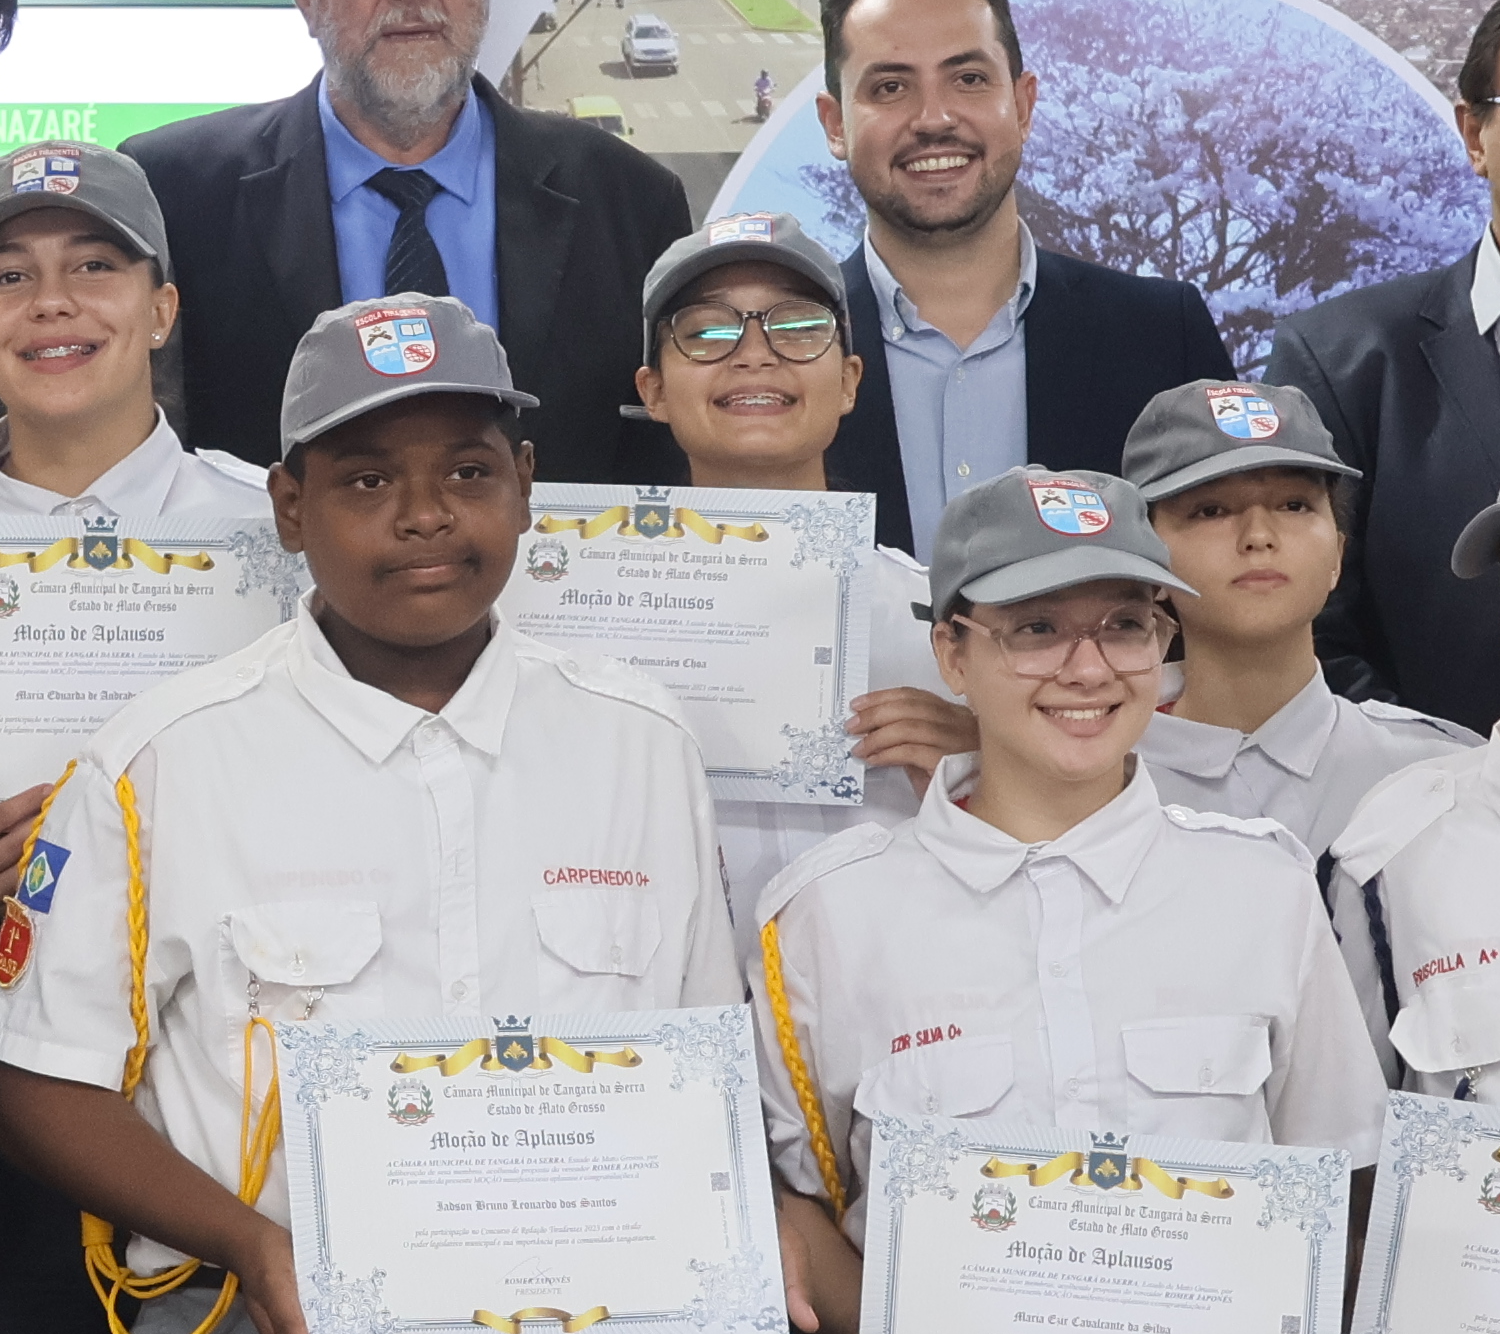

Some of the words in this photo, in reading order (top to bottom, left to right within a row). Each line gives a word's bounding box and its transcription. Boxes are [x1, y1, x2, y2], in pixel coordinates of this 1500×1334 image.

[355, 312, 383, 327] ESCOLA
[559, 589, 612, 609] Moção
[618, 592, 634, 606] de
[640, 592, 714, 610] Aplausos
[13, 624, 65, 645] Moção
[71, 626, 87, 641] de
[92, 625, 164, 643] Aplausos
[543, 867, 634, 886] CARPENEDO
[1412, 952, 1466, 988] PRISCILLA
[1479, 948, 1499, 965] A+
[915, 1026, 944, 1047] SILVA
[430, 1132, 486, 1152] Moção
[491, 1131, 509, 1146] de
[515, 1130, 594, 1149] Aplausos
[1006, 1241, 1062, 1264] Moção
[1069, 1246, 1086, 1263] de
[1092, 1248, 1173, 1271] Aplausos
